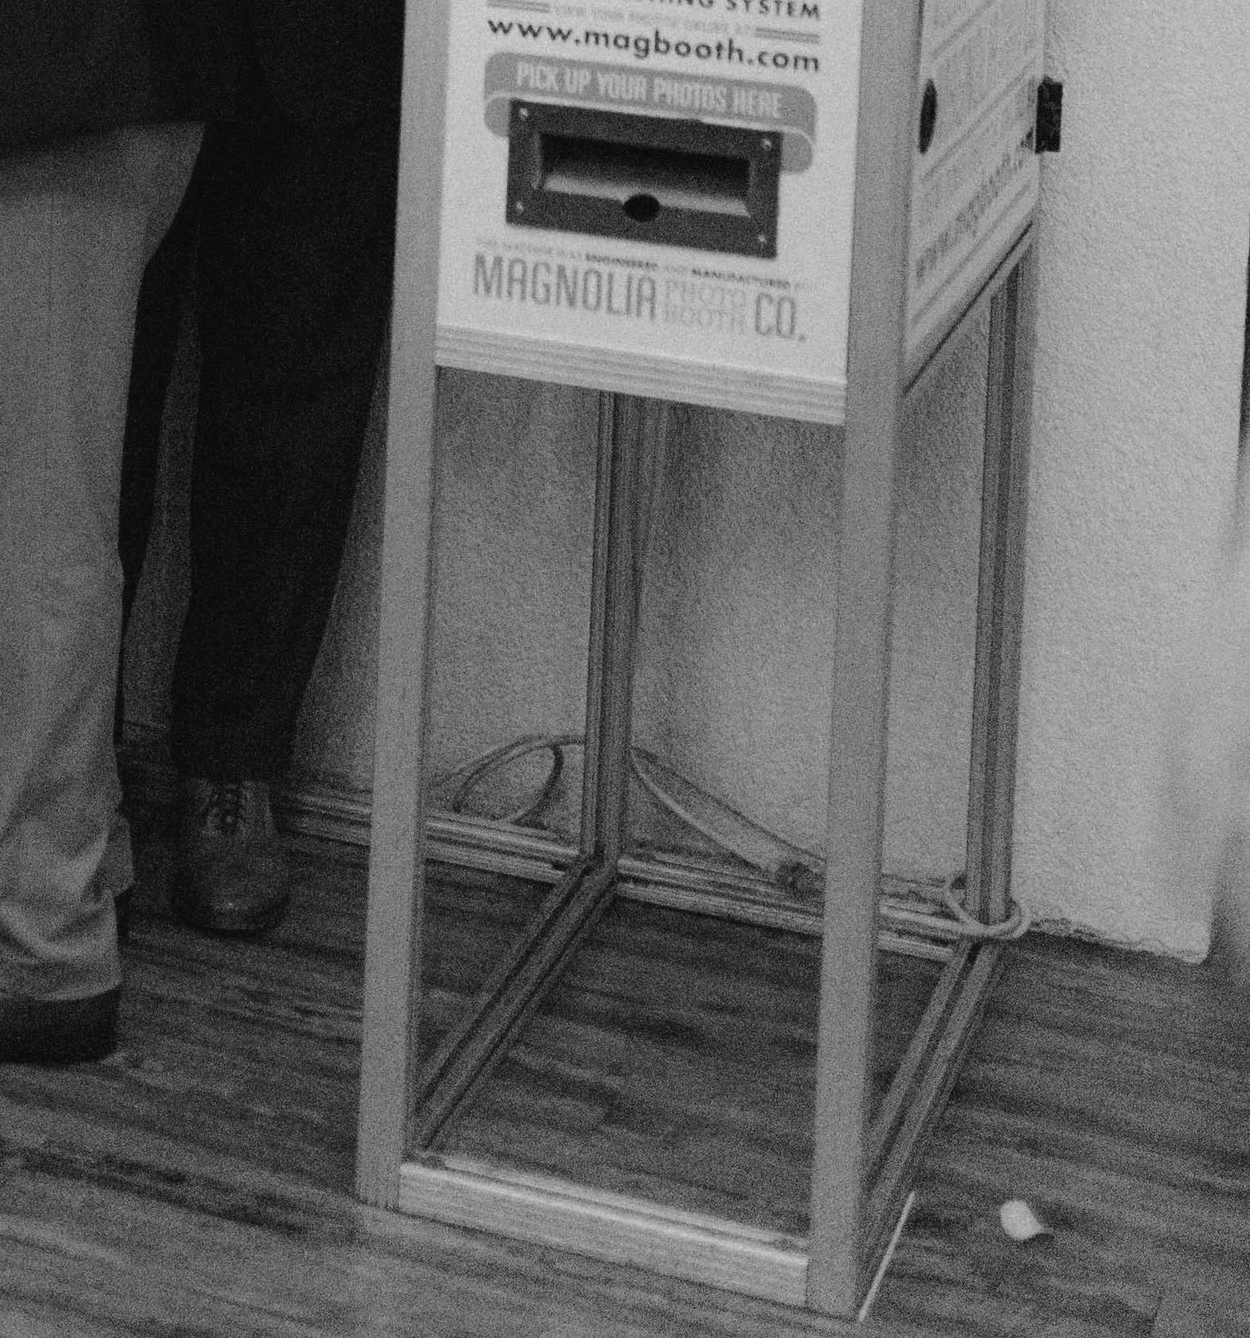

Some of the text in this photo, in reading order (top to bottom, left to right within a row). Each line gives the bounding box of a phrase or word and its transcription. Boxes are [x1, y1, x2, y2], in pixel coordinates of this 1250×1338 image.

[488, 19, 821, 72] www.magbooth.com
[516, 63, 784, 118] PICK UP YOUR PHOTOS HERE
[473, 253, 657, 322] MAGNOLIA
[664, 278, 747, 309] PHOTO
[663, 303, 746, 335] BOOTH
[753, 292, 808, 343] CO.
